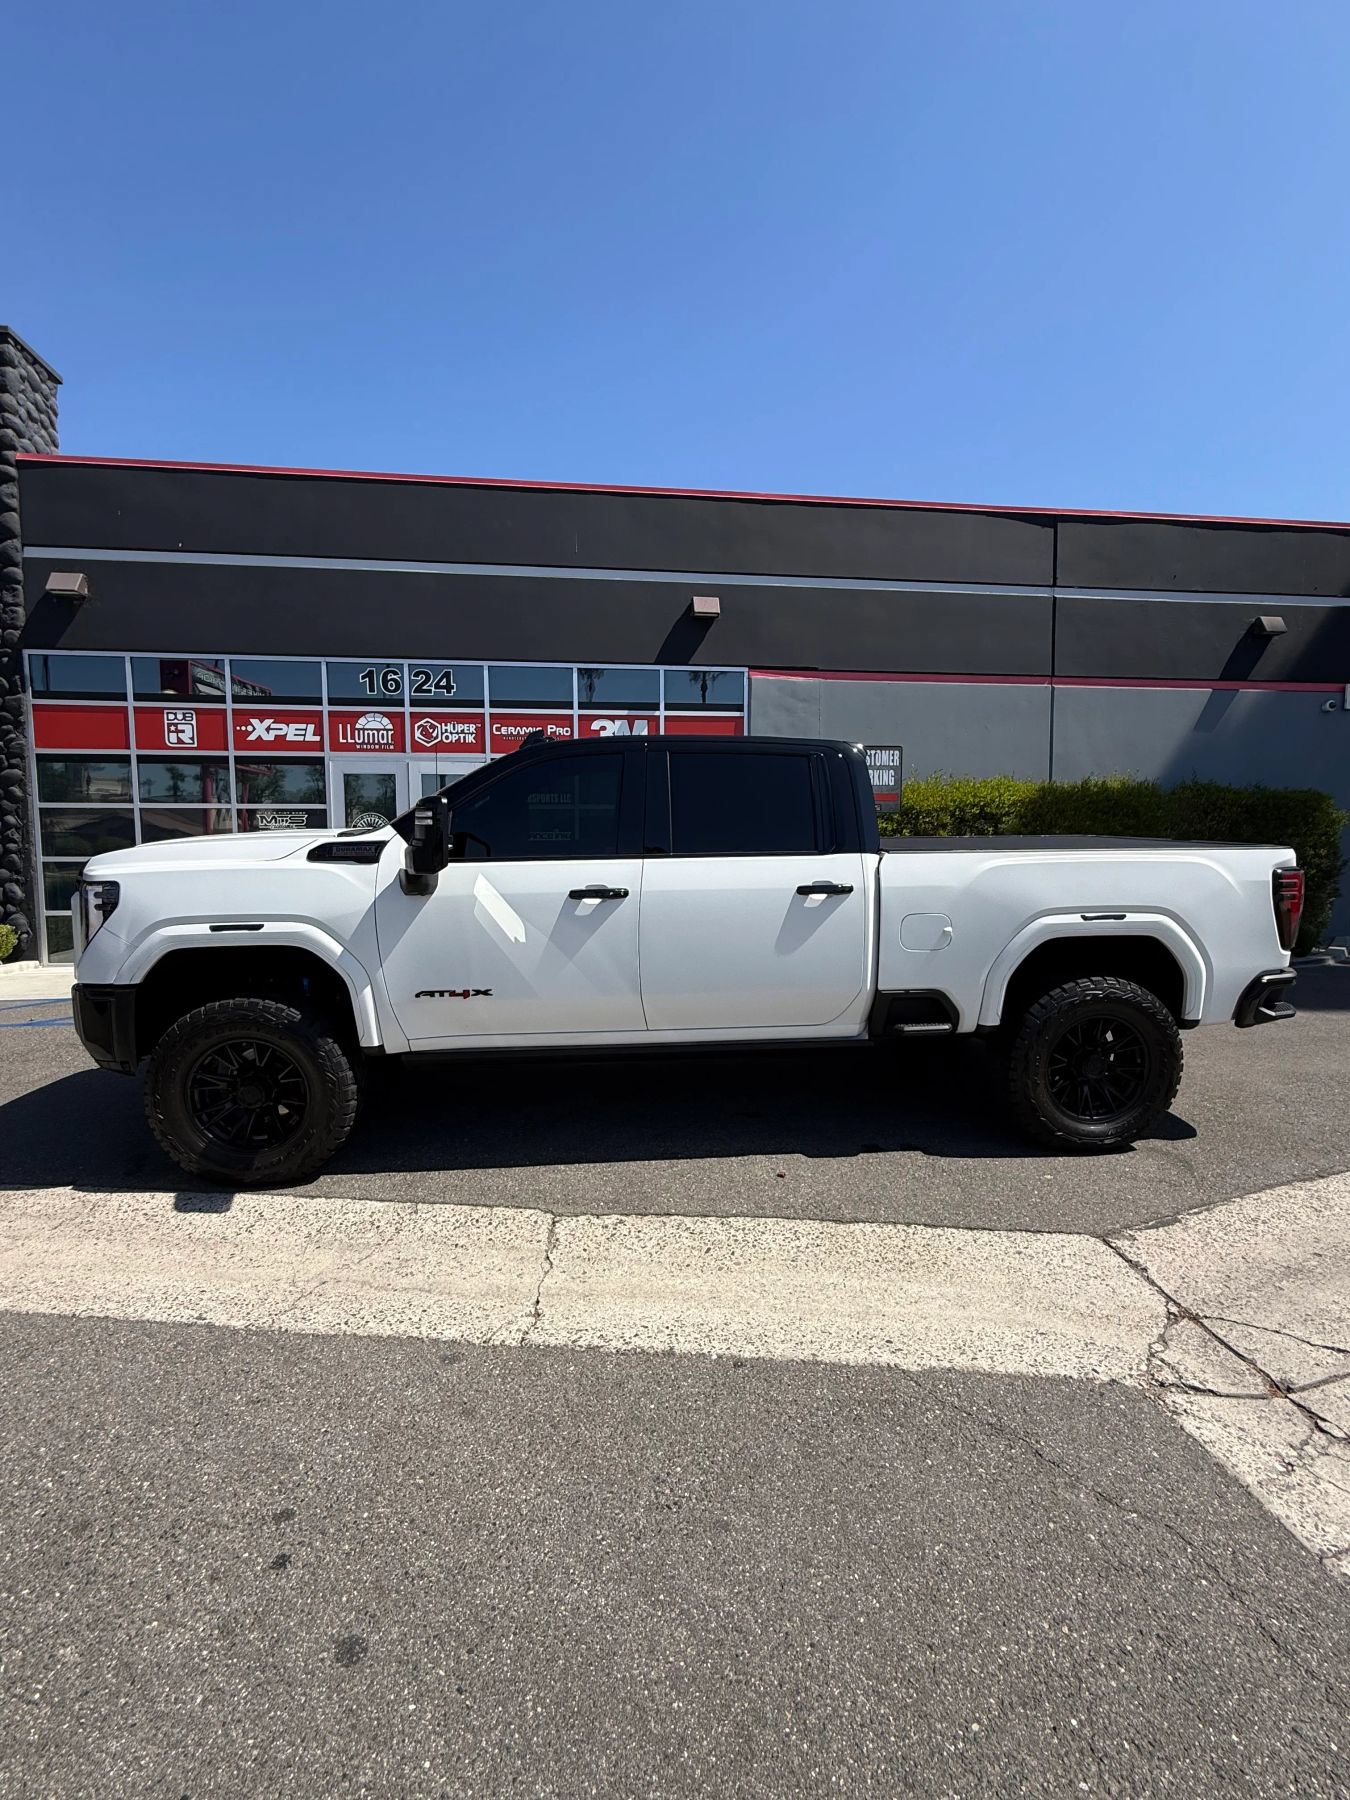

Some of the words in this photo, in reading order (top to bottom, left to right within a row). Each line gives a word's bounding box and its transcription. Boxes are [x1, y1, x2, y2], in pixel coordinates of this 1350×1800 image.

[166, 712, 194, 721] DUB
[246, 718, 320, 741] XPEL
[442, 733, 476, 743] OPTIK
[866, 750, 900, 766] STOMER
[869, 770, 895, 786] RKING
[415, 989, 493, 999] AT4X
